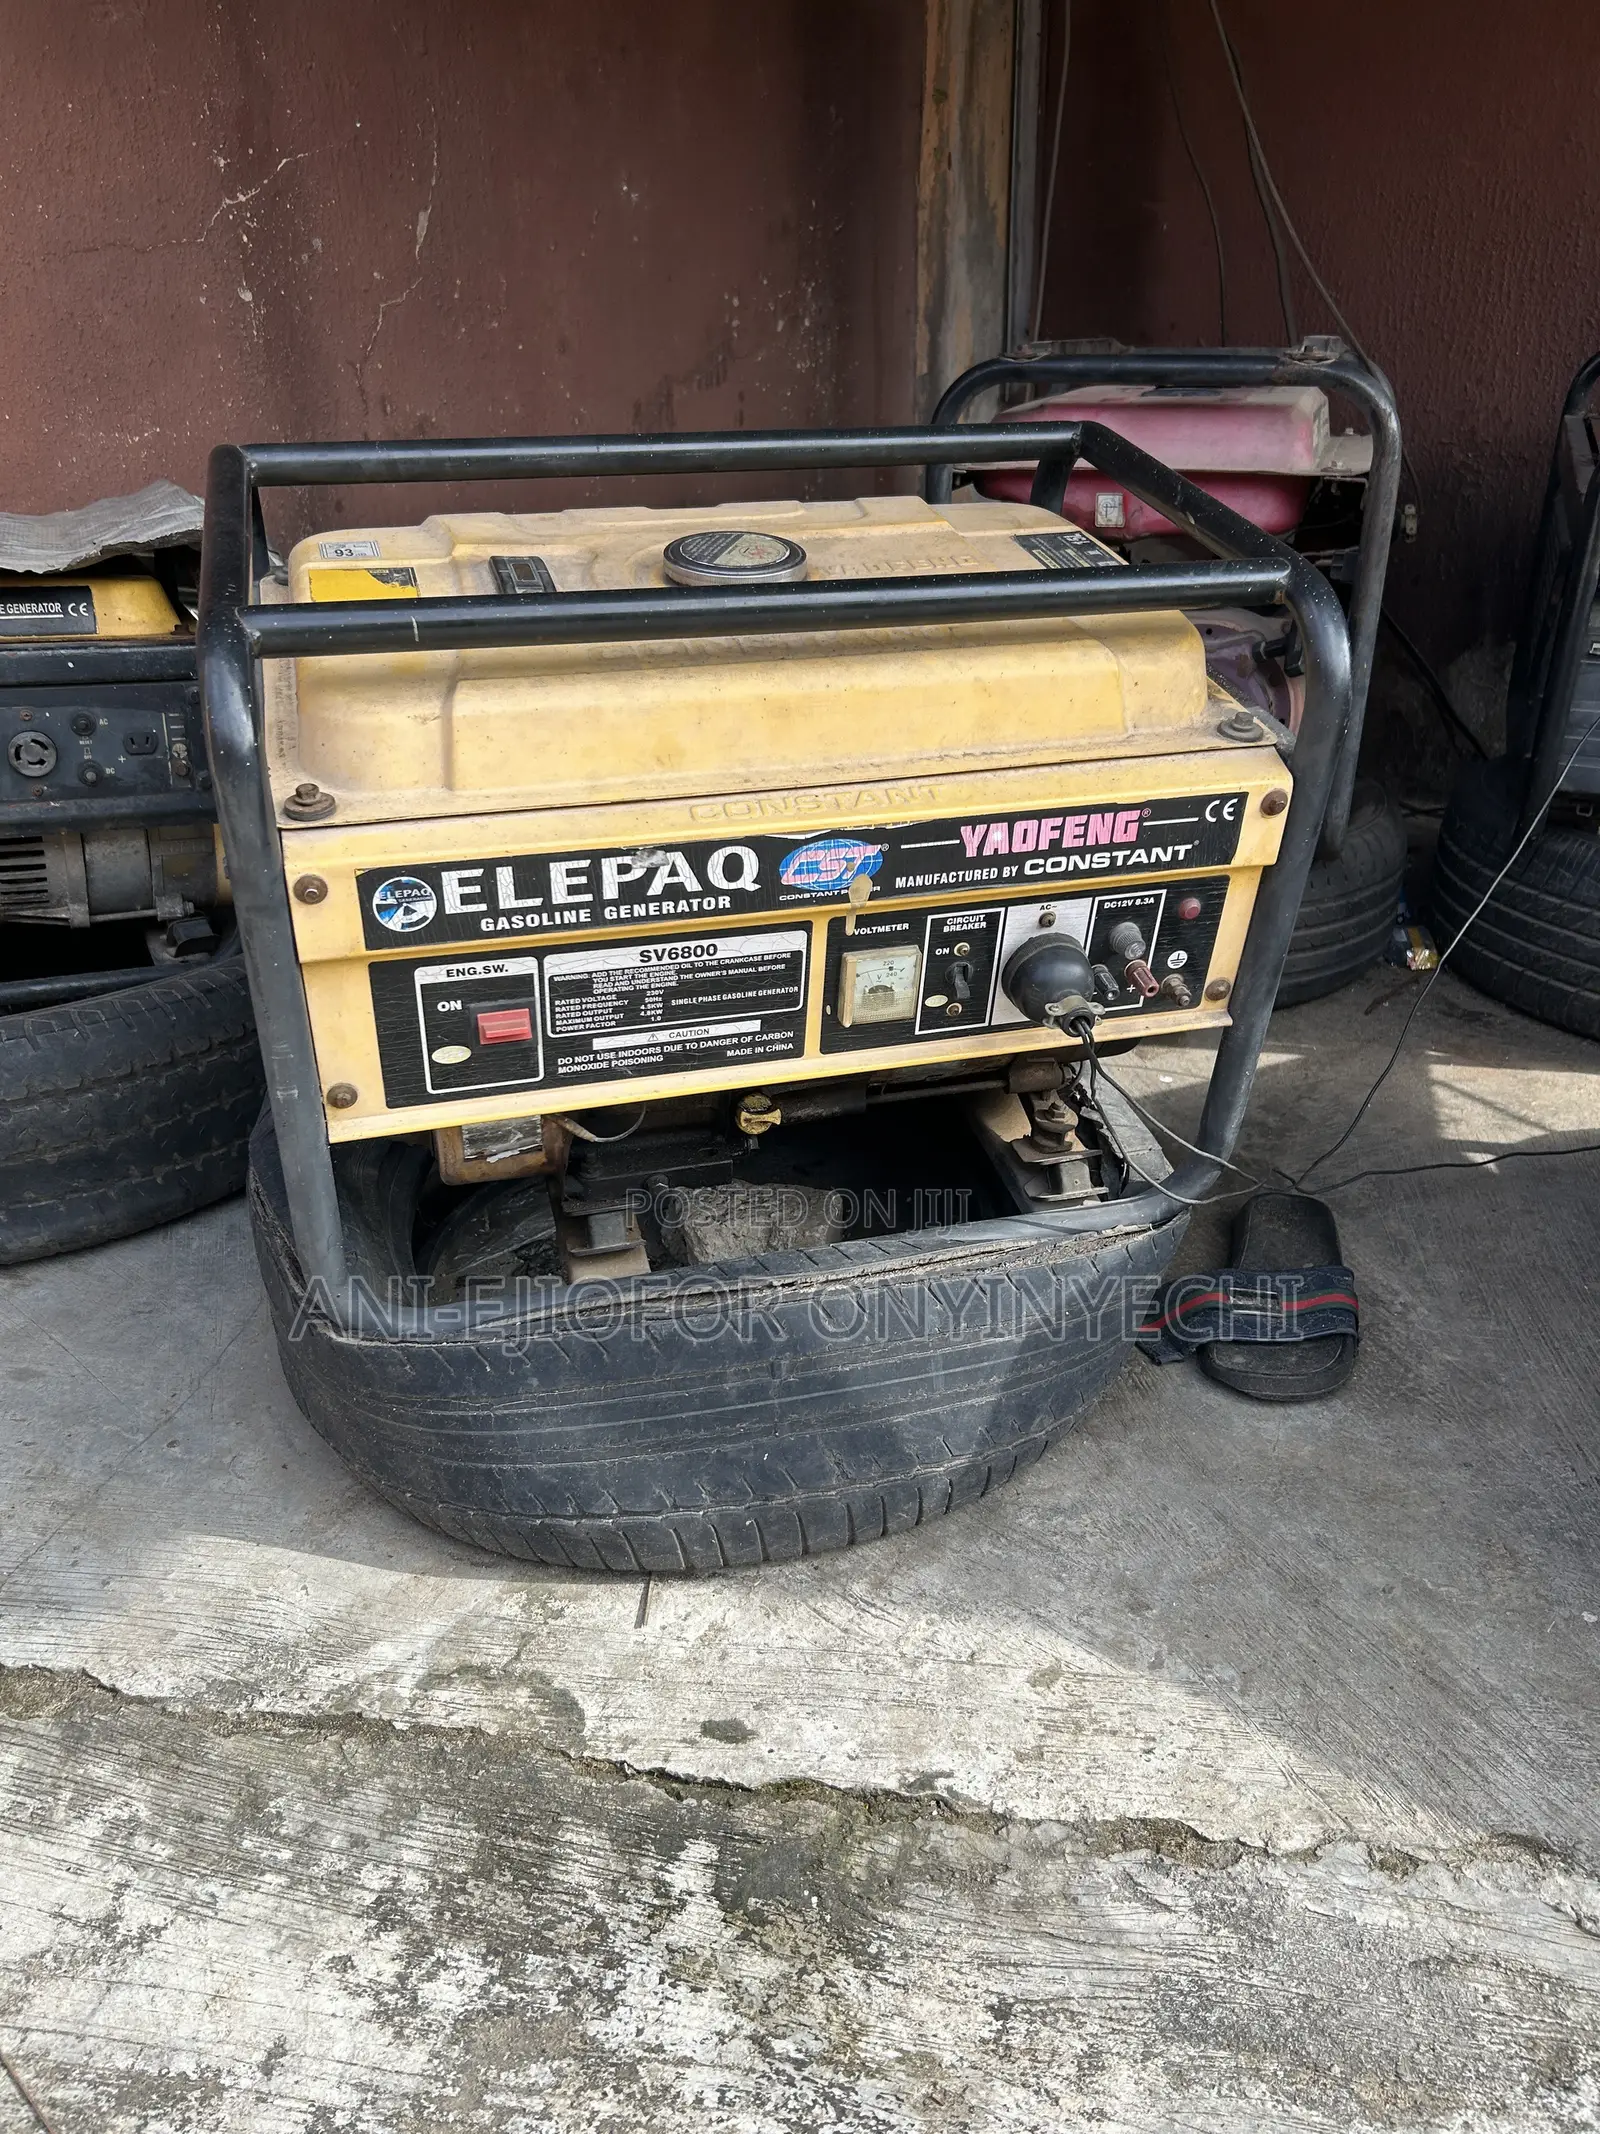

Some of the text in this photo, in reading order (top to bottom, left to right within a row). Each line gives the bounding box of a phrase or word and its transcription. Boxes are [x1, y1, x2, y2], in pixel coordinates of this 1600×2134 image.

[334, 548, 354, 557] 93
[6, 602, 62, 614] GENERATOR
[689, 784, 949, 823] CONSTANT
[1205, 798, 1238, 823] CE
[960, 810, 1142, 858] YAOFENG
[781, 845, 881, 885] CST
[895, 844, 1192, 889] MANUFACTURED BY CONSTANT
[441, 845, 762, 915] ELEPAQ
[379, 888, 431, 899] ELEPAQ
[779, 890, 840, 900] CONSTANT
[1104, 897, 1155, 909] DC12V 8.3A
[480, 895, 732, 932] GASOLINE GENERATOR
[946, 914, 986, 925] CIRCUIT
[854, 922, 910, 936] VOLTMETER
[943, 921, 987, 933] BREAKER
[639, 943, 718, 963] SV6800
[935, 948, 950, 956] ON
[446, 964, 509, 978] ENG.SW.
[624, 964, 680, 975] RECOMMENDED
[720, 956, 762, 965] CRANKCASE
[763, 953, 791, 961] BEFORE
[593, 981, 613, 989] READ
[631, 975, 678, 985] UNDERSTAND
[695, 970, 727, 979] OWNER'S
[728, 967, 757, 976] MANUAL
[758, 964, 786, 972] BEFORE
[650, 970, 677, 978] ENGINE.
[593, 985, 634, 995] OPERATING
[651, 980, 679, 989] ENGINE.
[555, 997, 580, 1006] RATED
[582, 994, 617, 1003] VOLTAGE
[671, 986, 799, 1006] SINGLE PHASE GASOLINE GENERATOR
[437, 1000, 462, 1012] ON
[555, 1004, 580, 1013] RATED
[582, 1000, 629, 1010] FREQUENCY
[556, 1010, 583, 1019] RATED
[584, 1008, 613, 1016] OUTPUT
[556, 1017, 592, 1026] MAXIMUM
[593, 1013, 624, 1021] OUTPUT
[556, 1024, 584, 1033] POWER
[586, 1021, 616, 1029] FACTOR
[669, 1028, 710, 1039] CAUTION
[557, 1031, 794, 1065] DO NOT USE INDOORS DUE TO DANGER OF CARBON
[726, 1042, 794, 1057] MADE IN CHINA
[557, 1054, 664, 1074] MONOXIDE POISONING
